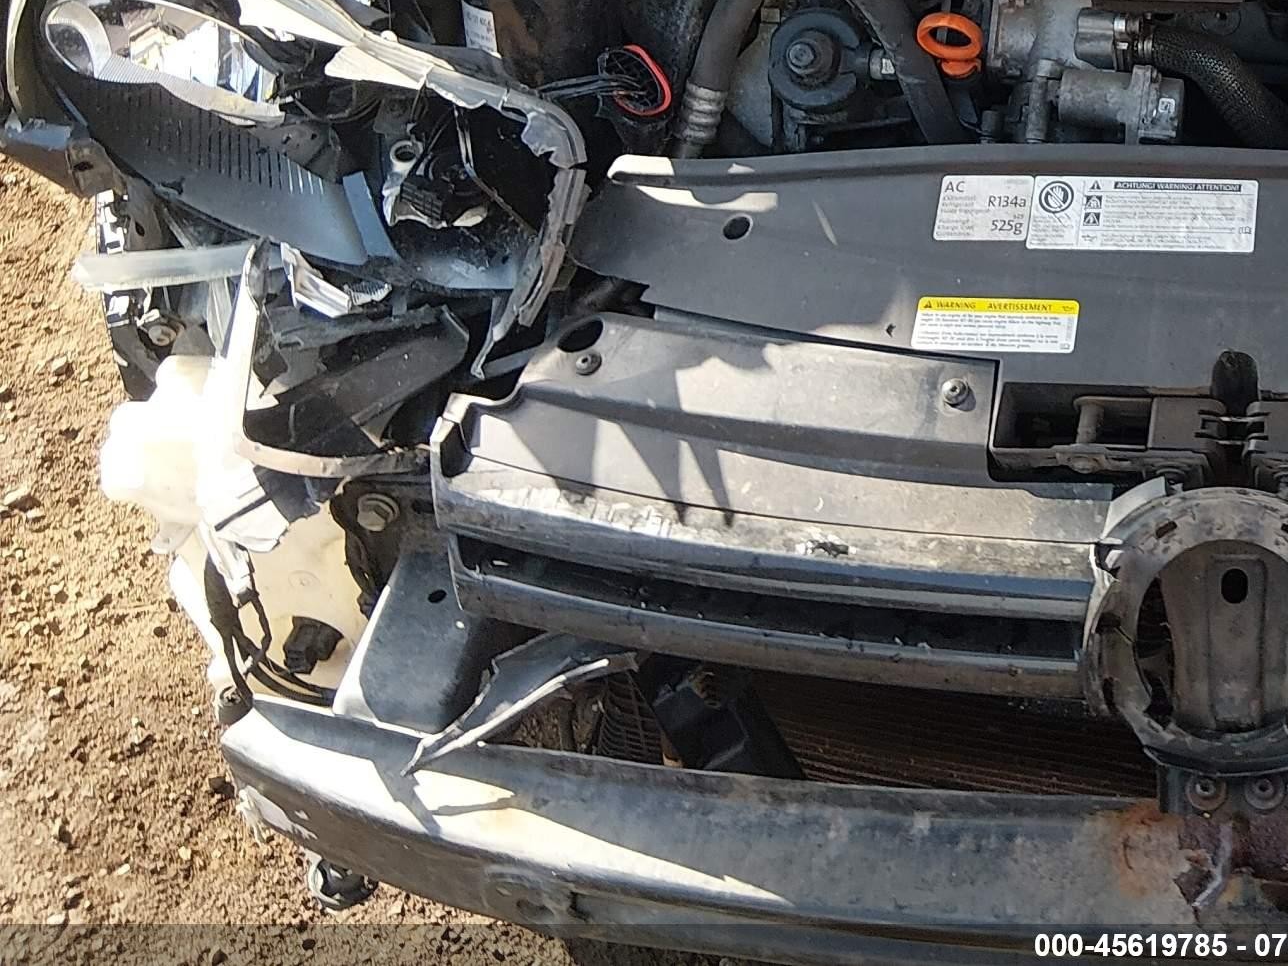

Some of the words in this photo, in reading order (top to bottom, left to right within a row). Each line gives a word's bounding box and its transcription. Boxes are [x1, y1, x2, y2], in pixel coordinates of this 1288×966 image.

[944, 181, 965, 193] AC
[1116, 181, 1156, 190] ACHTUNG!
[1156, 182, 1196, 191] WARNING!
[1196, 184, 1240, 192] ATTENTION!
[988, 195, 1027, 208] R134a
[991, 219, 1024, 235] 525g
[936, 301, 976, 309] WARNING
[987, 302, 1053, 311] AVERTISSEMENT
